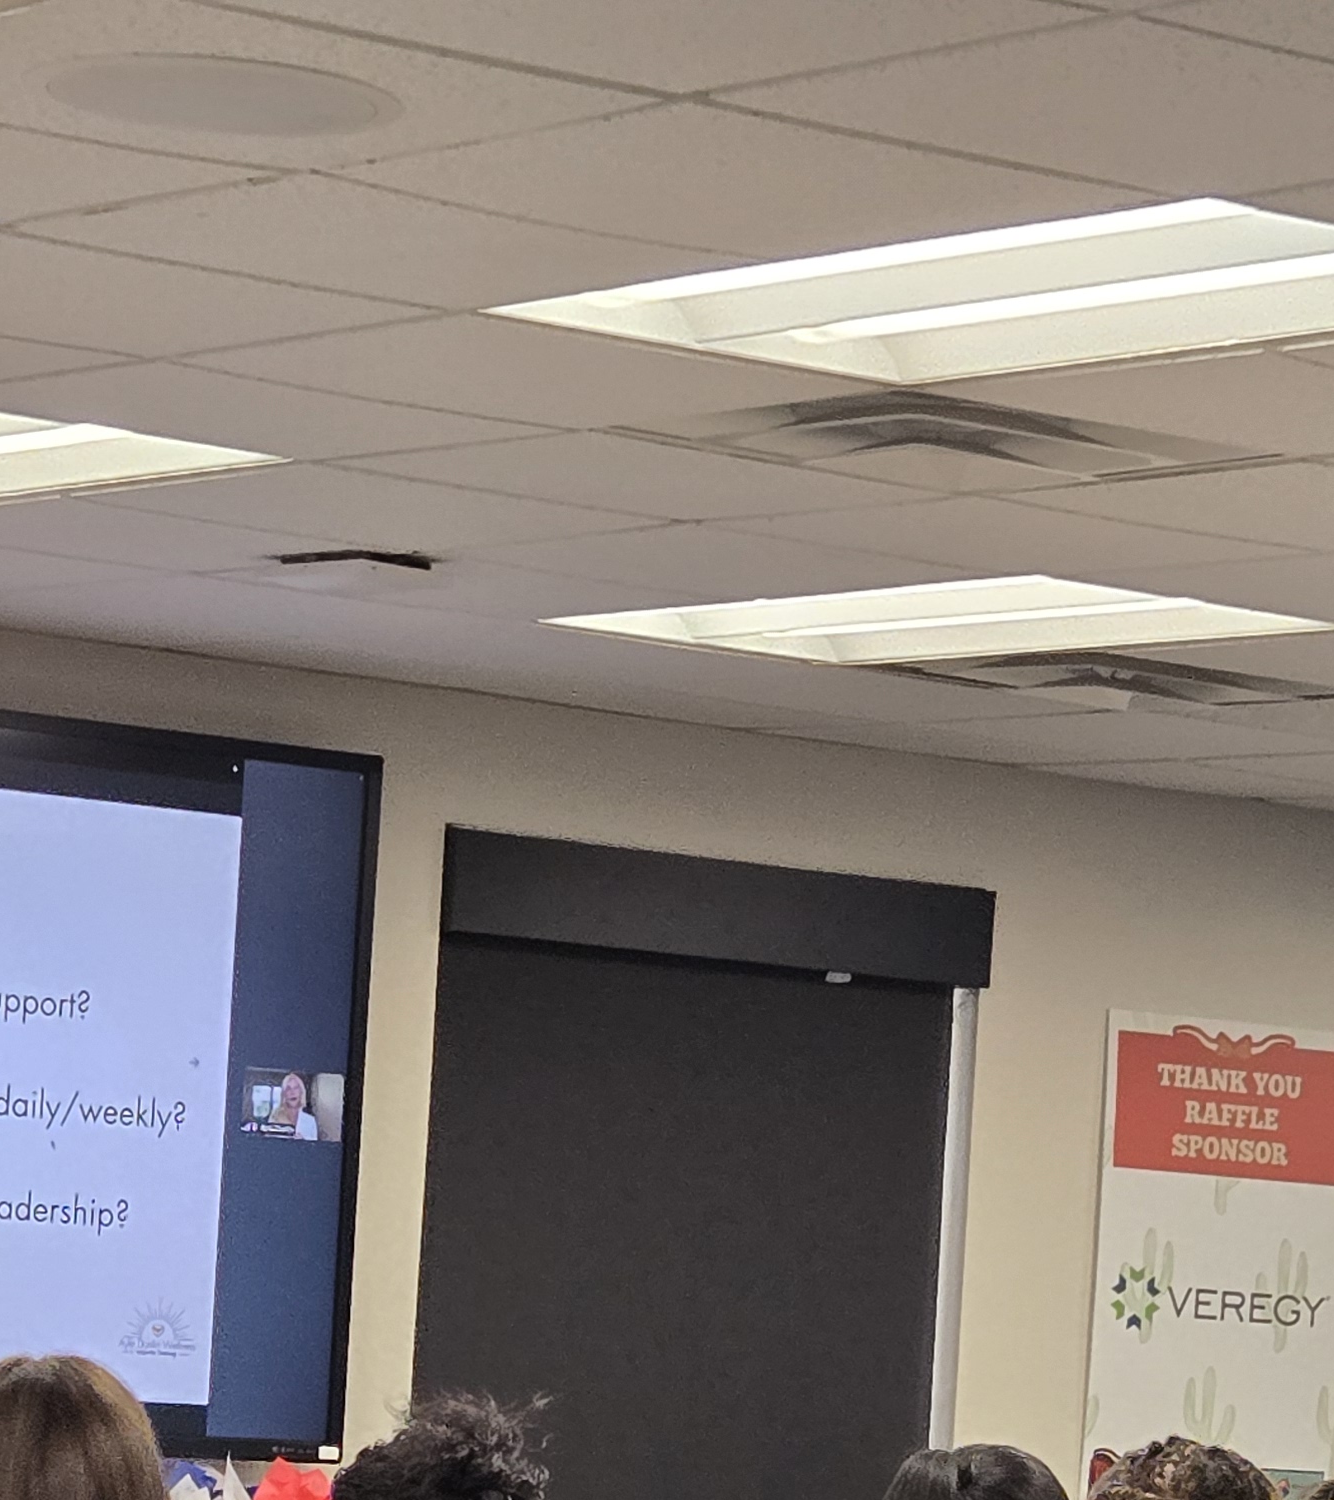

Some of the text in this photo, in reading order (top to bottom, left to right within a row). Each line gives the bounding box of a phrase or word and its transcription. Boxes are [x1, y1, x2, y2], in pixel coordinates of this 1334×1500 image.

[1157, 1063, 1302, 1099] THANK YOU
[1184, 1100, 1279, 1131] RAFFLE
[1171, 1133, 1288, 1166] SPONSOR
[1167, 1286, 1327, 1328] VEREGY
